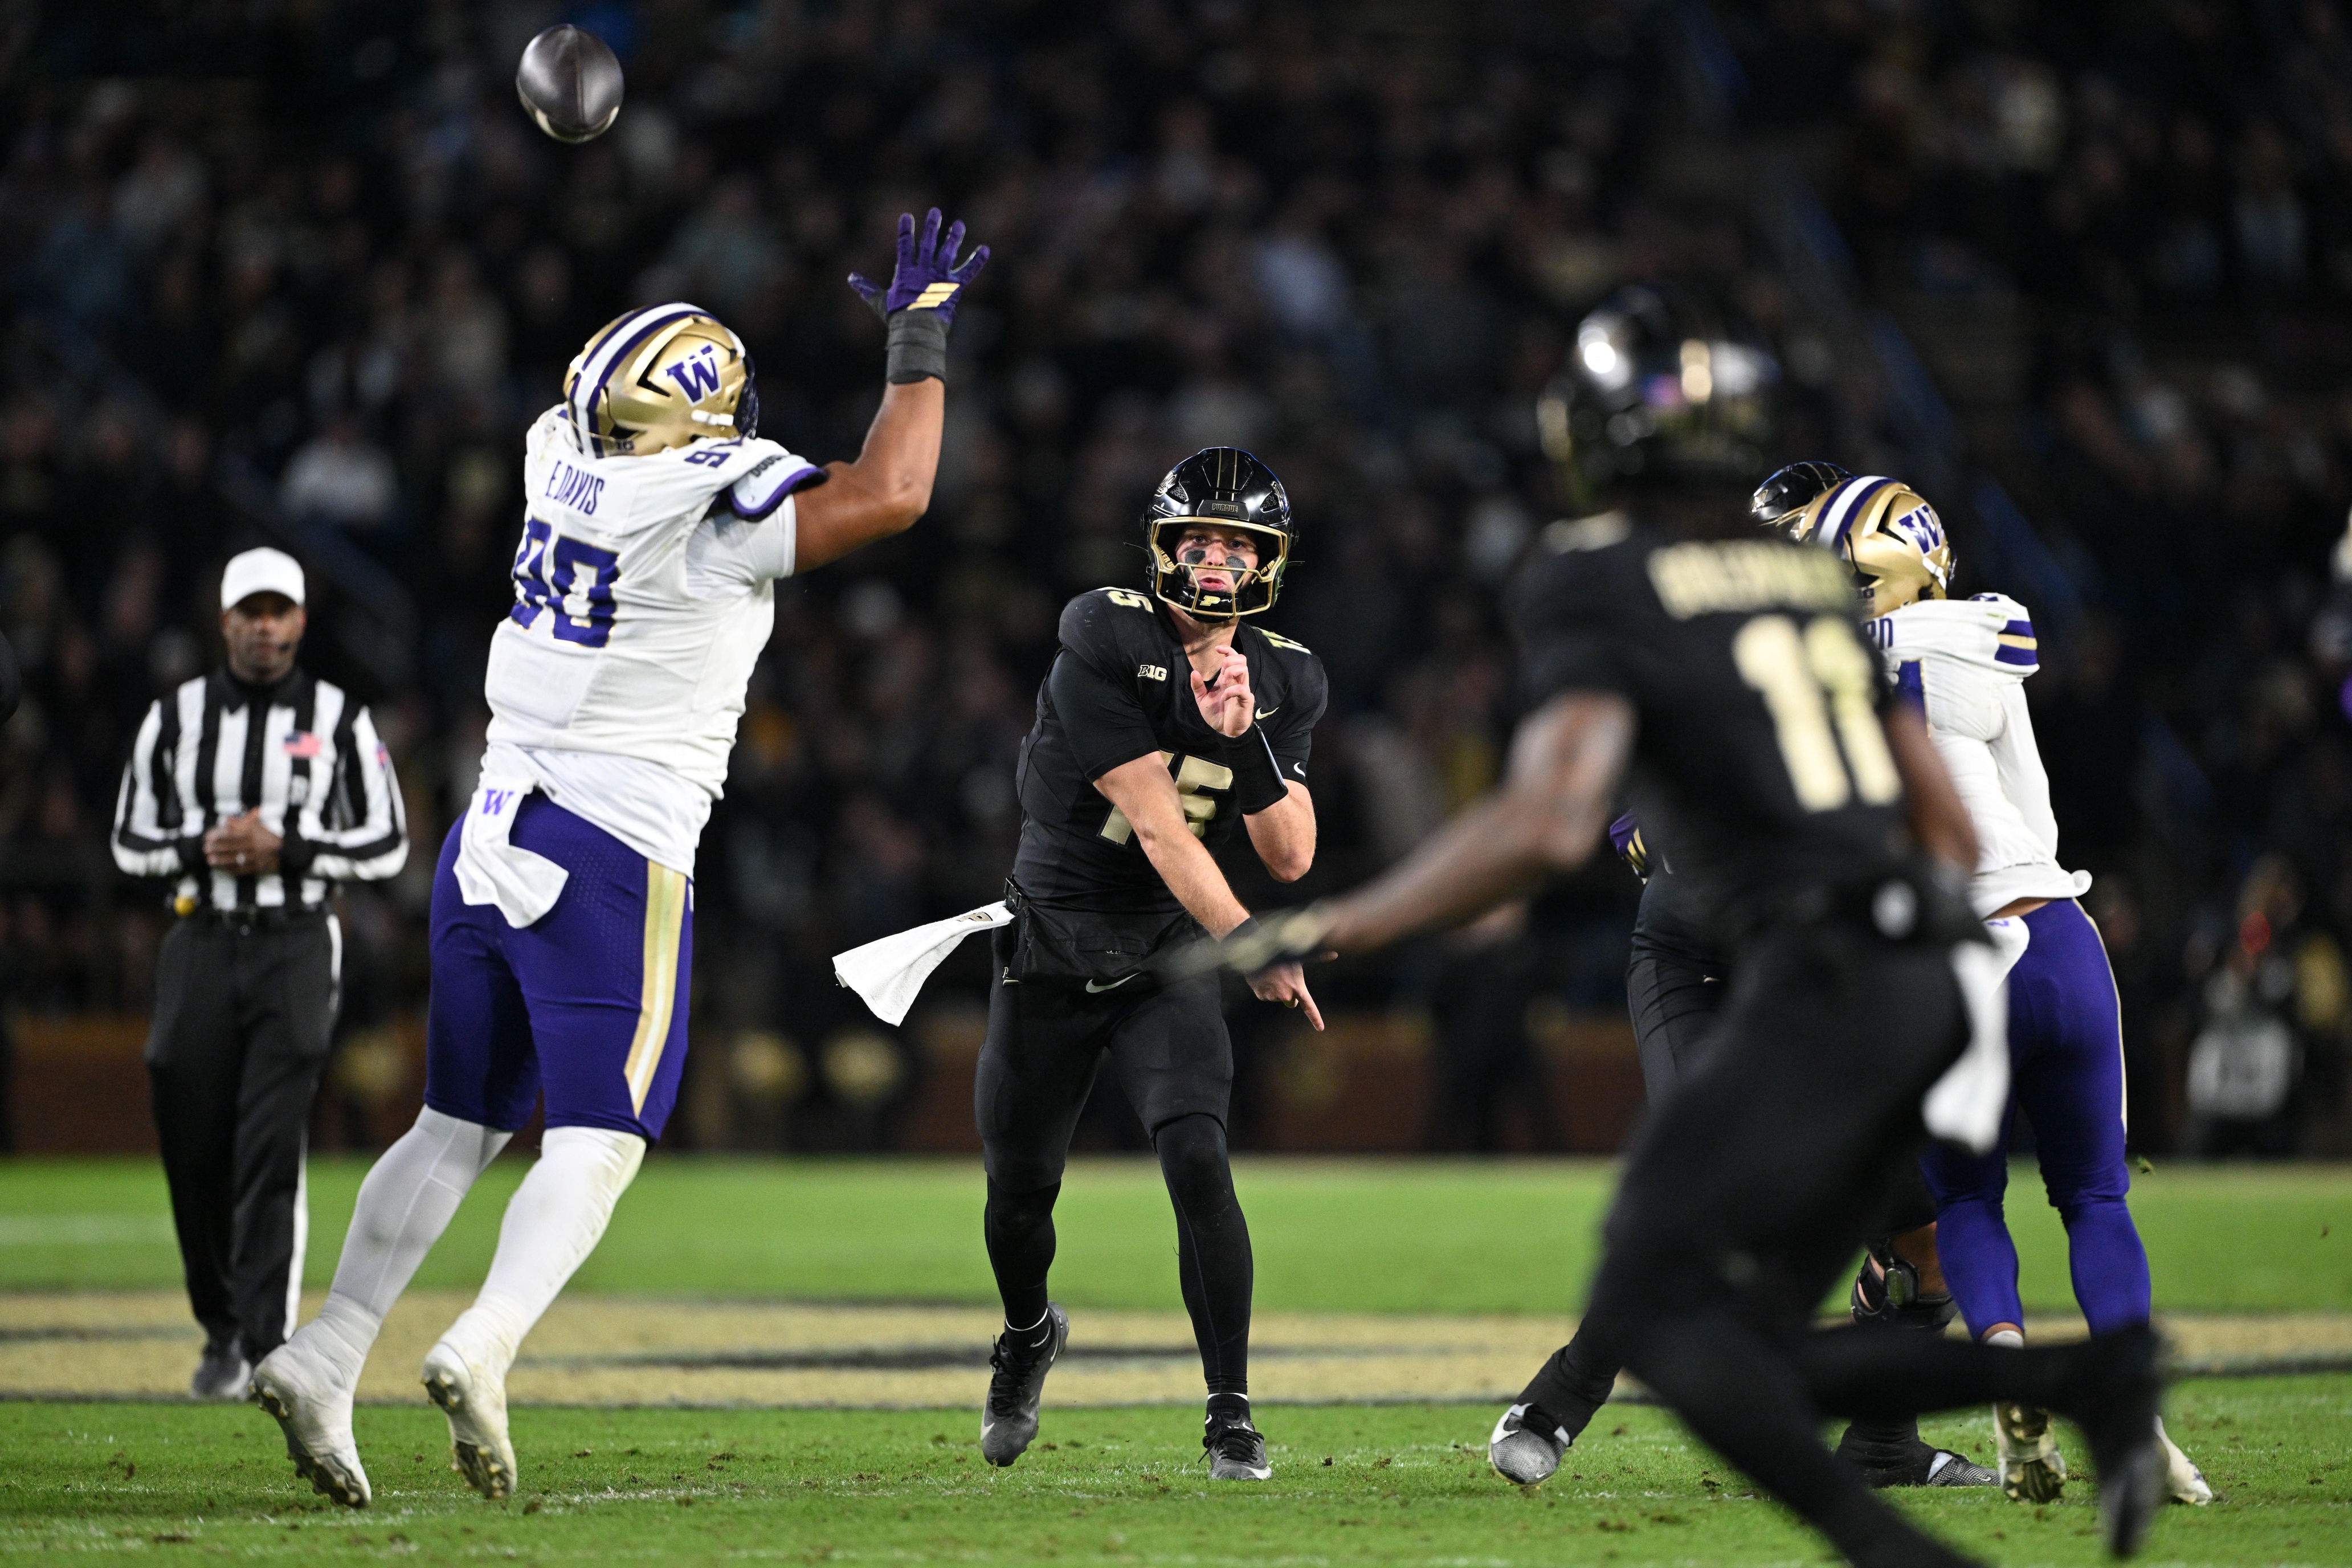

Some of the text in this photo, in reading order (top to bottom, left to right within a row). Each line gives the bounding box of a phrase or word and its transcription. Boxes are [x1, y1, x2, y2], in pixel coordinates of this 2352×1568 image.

[665, 344, 721, 405] W
[1211, 503, 1238, 513] PURDUE
[511, 516, 621, 648] 90
[1200, 595, 1220, 606] P
[483, 789, 514, 815] W
